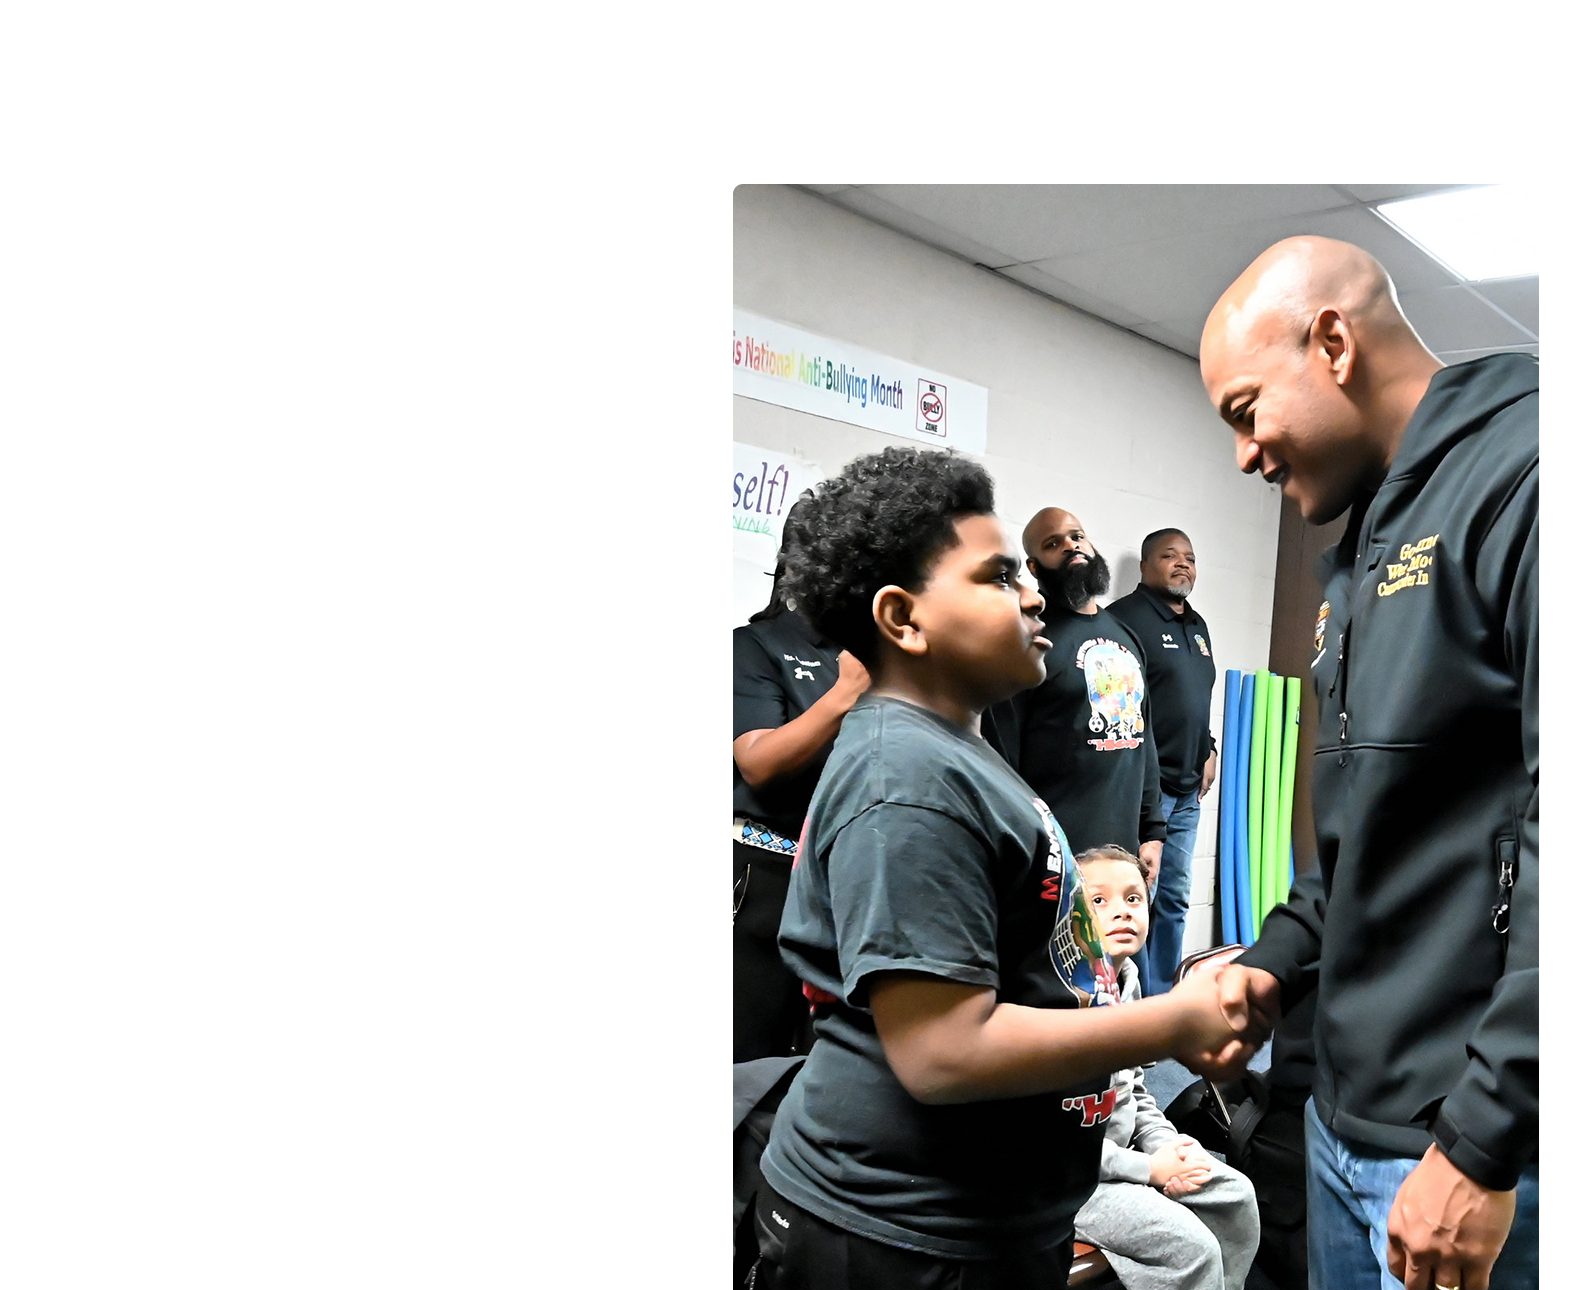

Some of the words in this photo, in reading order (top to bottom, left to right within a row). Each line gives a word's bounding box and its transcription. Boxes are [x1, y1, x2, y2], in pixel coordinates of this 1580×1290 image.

[745, 336, 796, 379] National
[798, 353, 868, 408] Anti-Bullying
[870, 373, 903, 410] Month
[925, 422, 938, 432] ZONE
